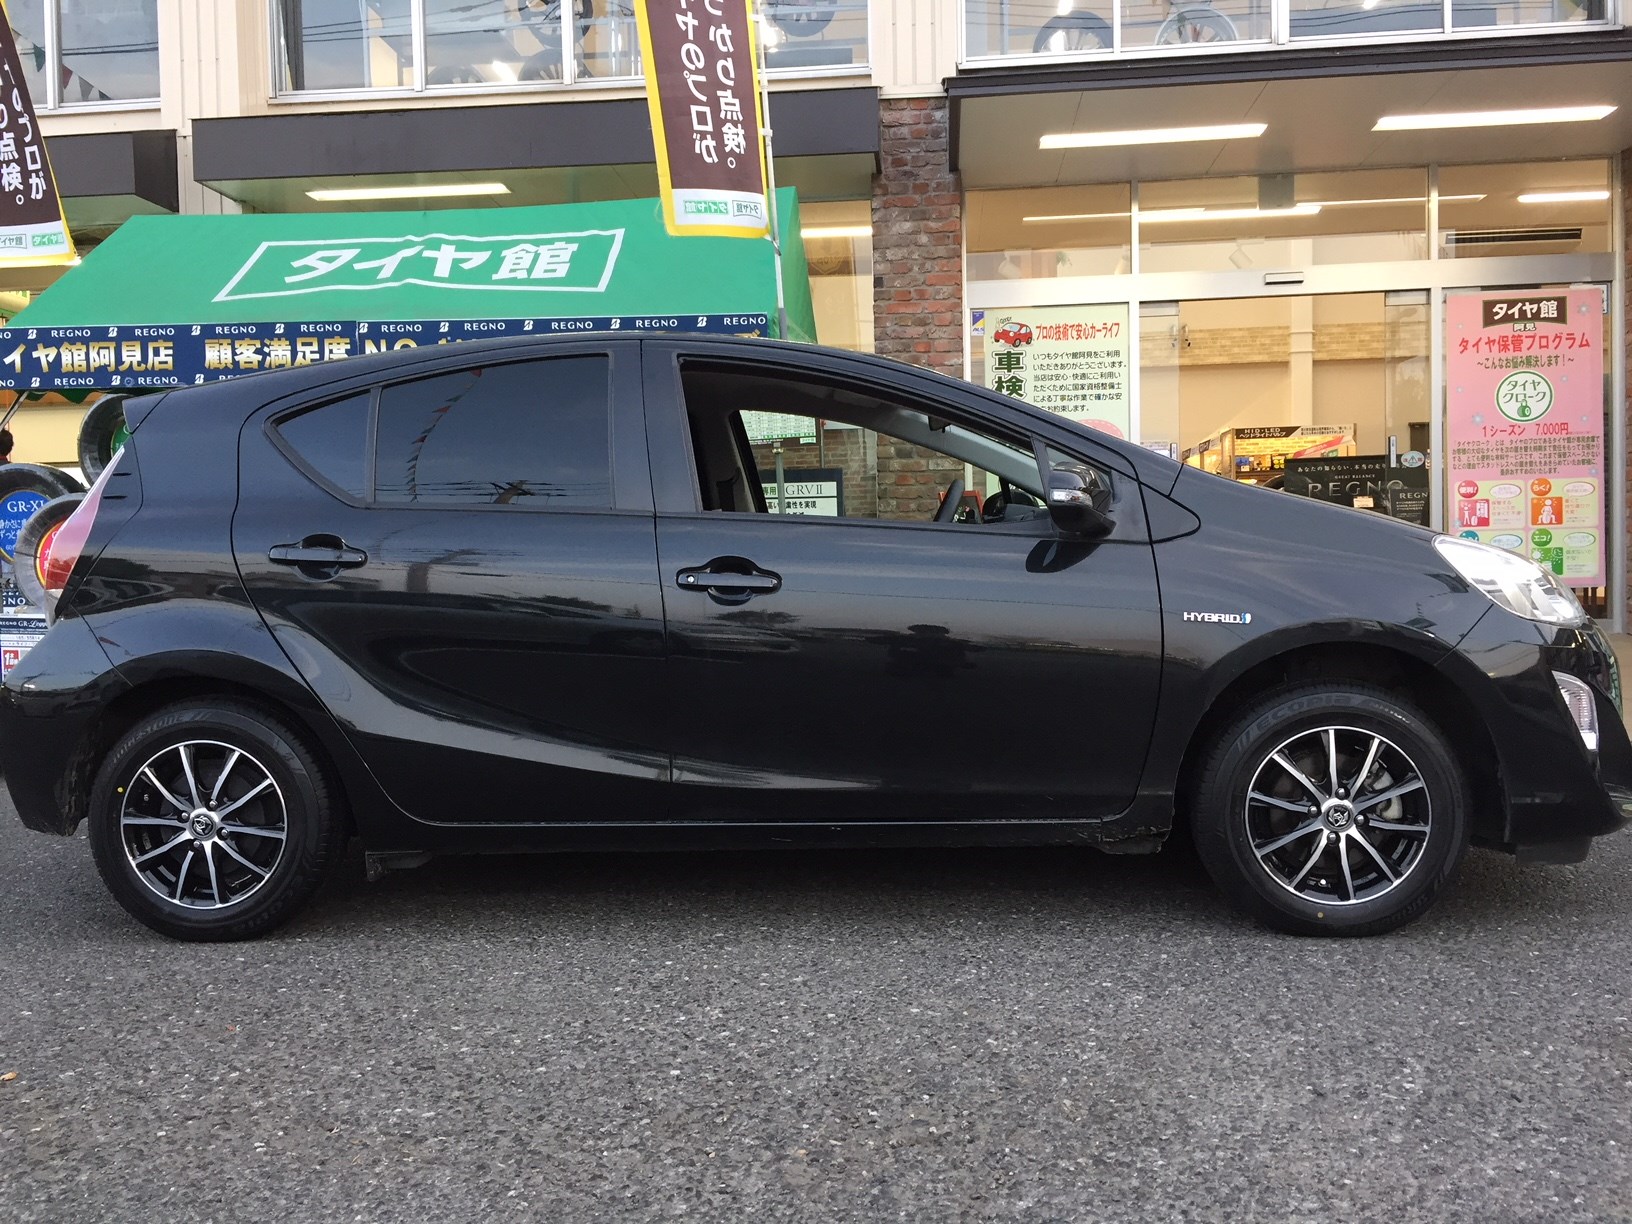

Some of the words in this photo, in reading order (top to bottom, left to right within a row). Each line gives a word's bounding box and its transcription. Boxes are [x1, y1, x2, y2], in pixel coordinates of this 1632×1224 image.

[0, 234, 23, 247] イヤ館
[284, 241, 579, 284] タイヤ館
[1492, 300, 1558, 320] タイヤ館
[51, 329, 91, 338] REGNO
[134, 327, 175, 337] REGNO
[215, 325, 257, 335] REGNO
[300, 323, 342, 333] REGNO
[381, 324, 423, 333] REGNO
[464, 322, 506, 331] REGNO
[551, 321, 594, 330] REGNO
[635, 318, 678, 328] REGNO
[723, 316, 766, 326] REGNO
[1035, 322, 1120, 341] プロの技術で安心カーライフ
[1513, 322, 1537, 332] 阿見
[1458, 332, 1591, 354] タイヤ保管プログラム
[204, 336, 351, 370] 顧客満足度
[54, 377, 94, 386] REGNO
[138, 376, 178, 386] REGNO
[993, 350, 1026, 398] 車検
[1506, 379, 1541, 392] タイヤ
[1502, 391, 1547, 404] クローク
[1183, 611, 1241, 624] HYBRID
